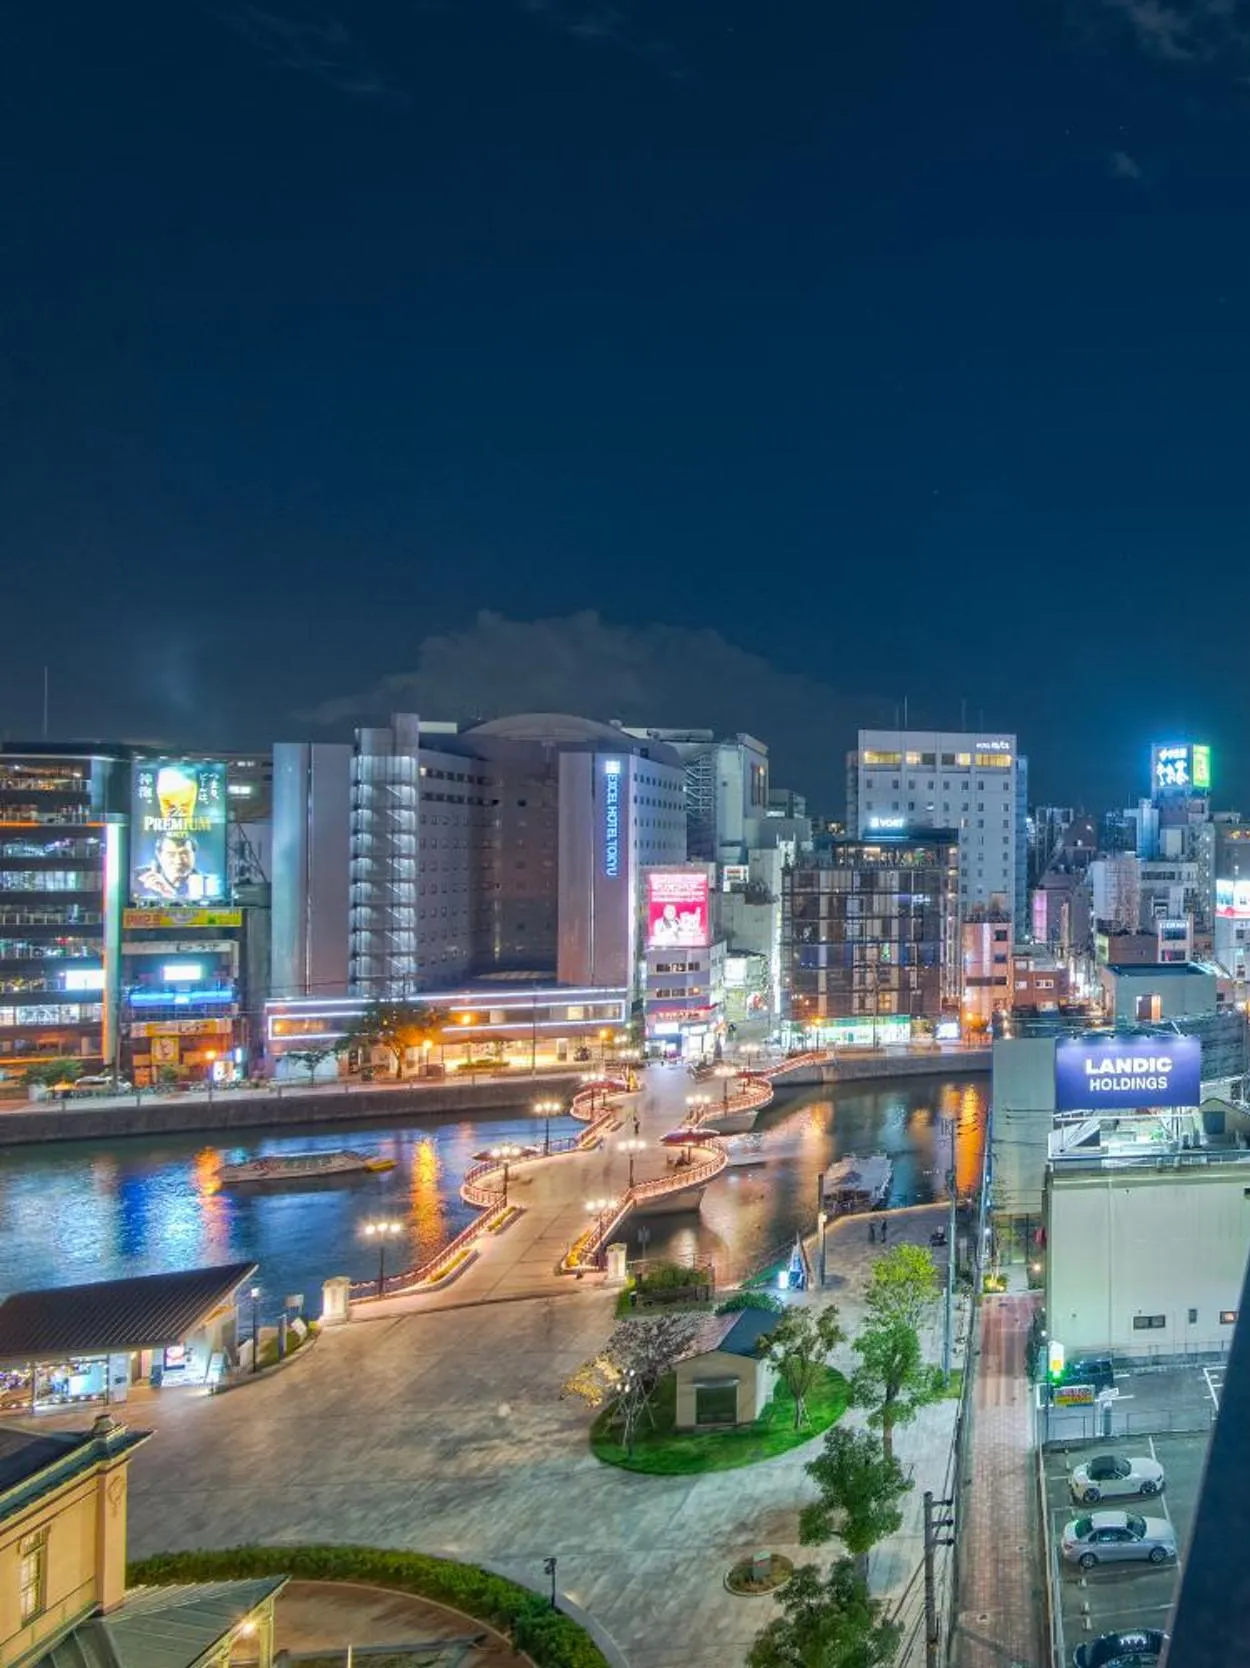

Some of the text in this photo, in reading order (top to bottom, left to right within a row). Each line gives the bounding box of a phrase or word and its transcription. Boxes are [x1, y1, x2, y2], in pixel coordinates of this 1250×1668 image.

[143, 816, 211, 831] PREMIUM
[606, 774, 618, 876] EXCEL HOTEL TOKYU
[1085, 1056, 1172, 1075] LANDIC
[1089, 1076, 1168, 1092] HOLDINGS
